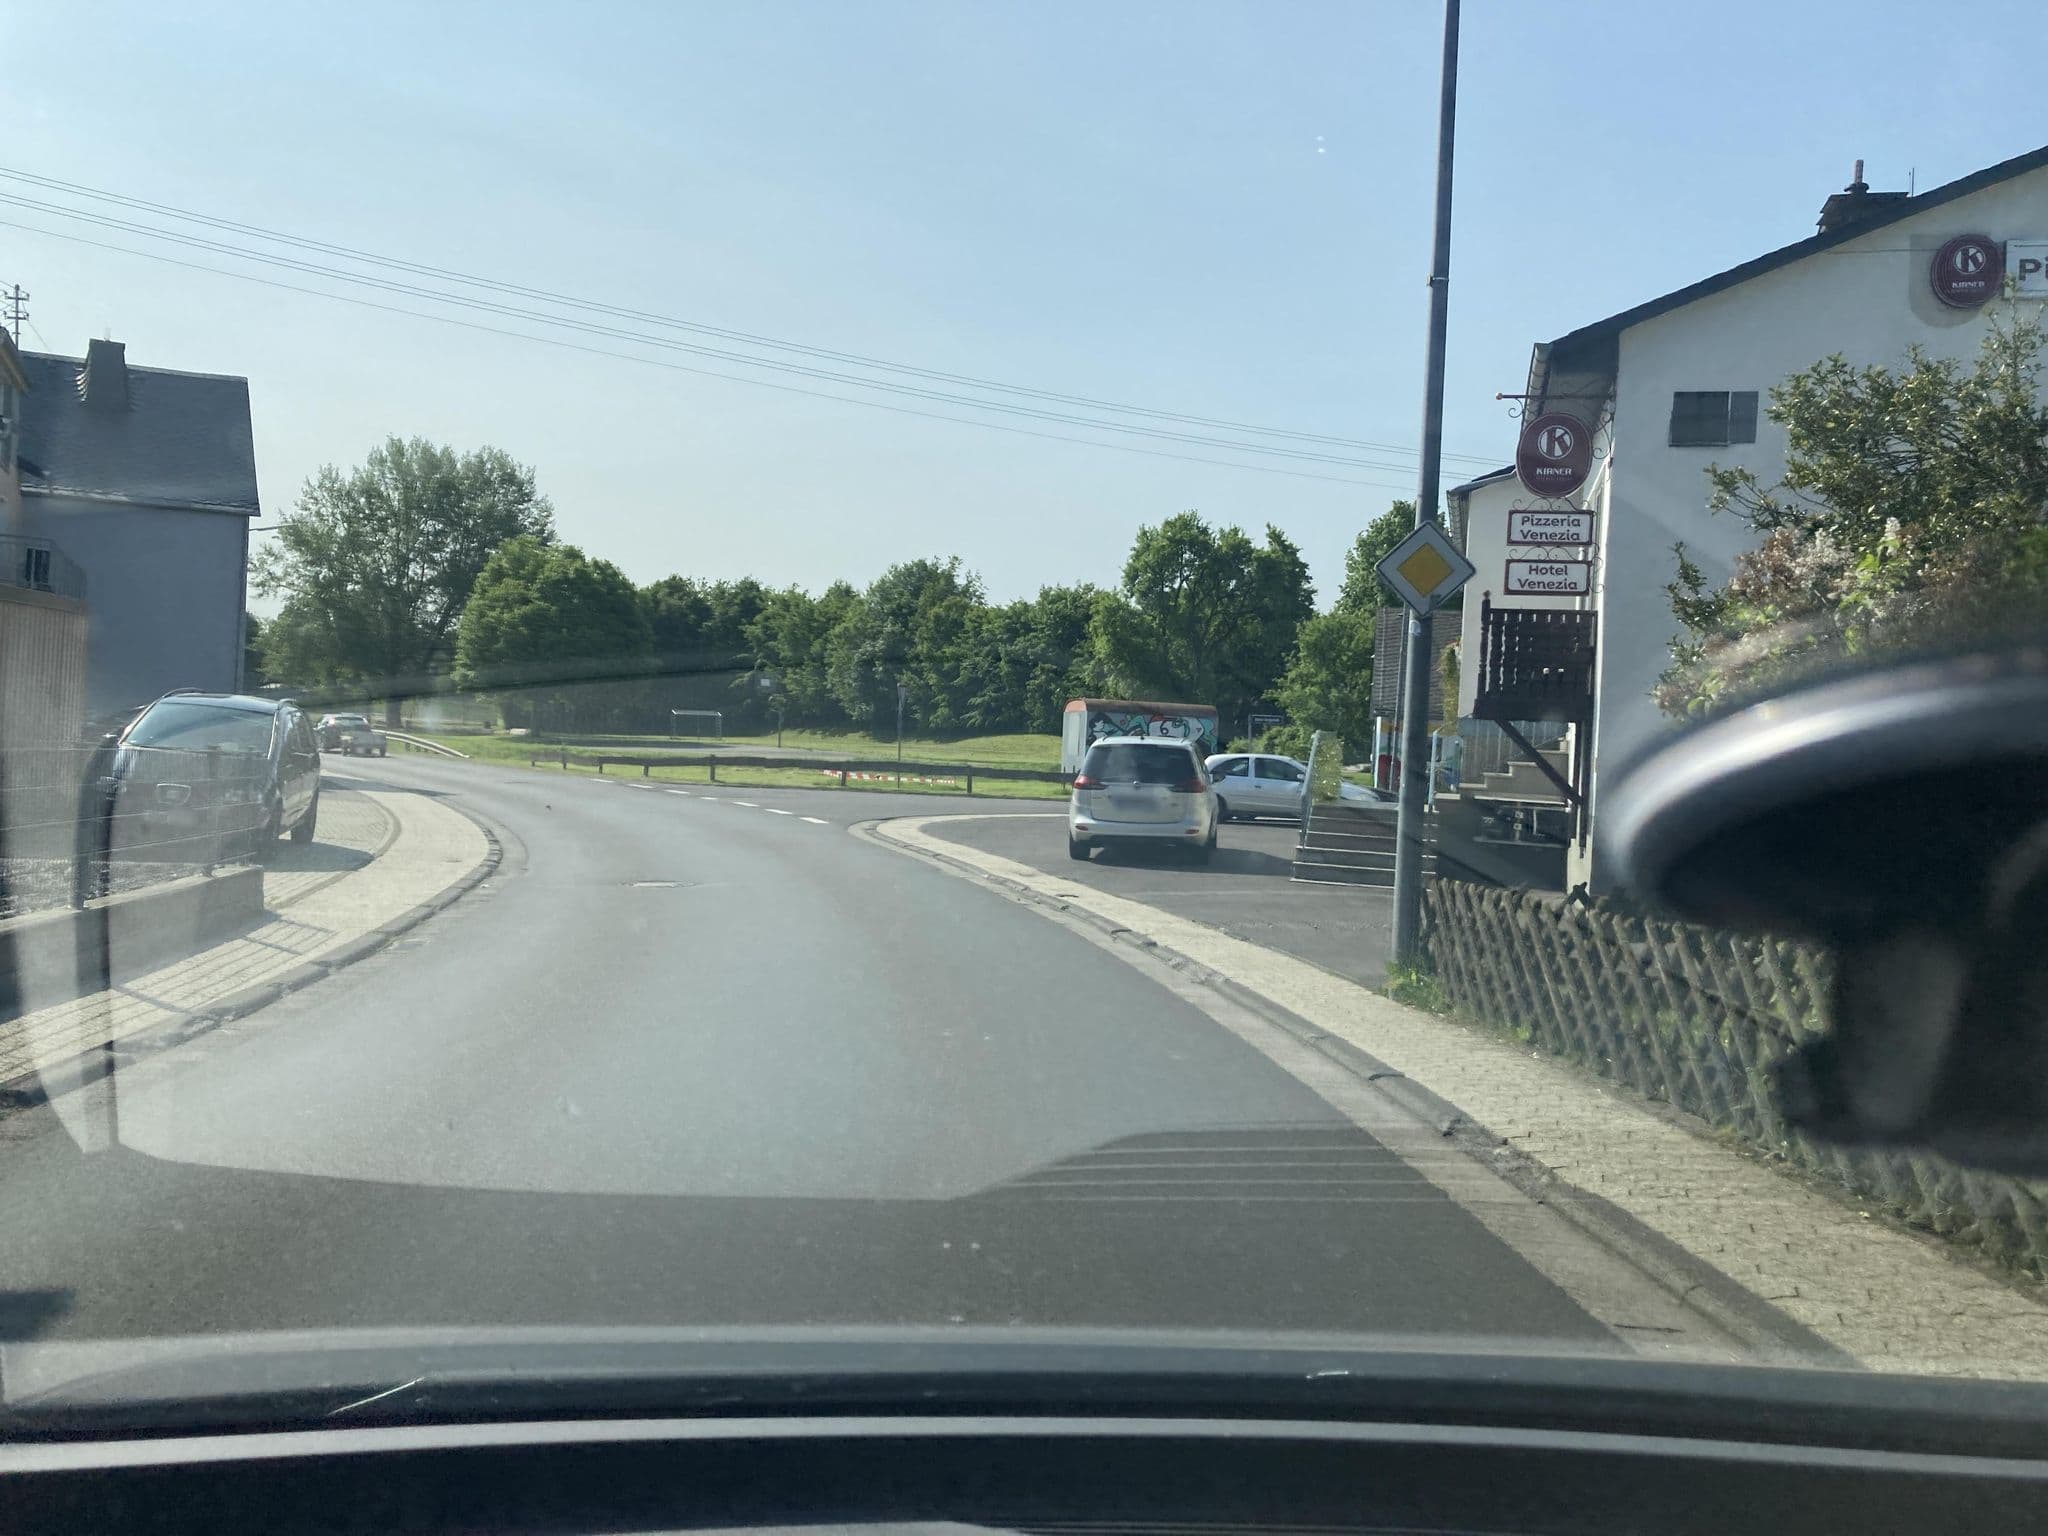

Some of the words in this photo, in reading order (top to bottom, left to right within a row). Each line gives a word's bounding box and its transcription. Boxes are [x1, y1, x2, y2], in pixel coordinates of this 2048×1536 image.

[1539, 426, 1573, 459] K
[1536, 467, 1572, 476] KIRNER
[1521, 515, 1581, 528] Pizzeria
[1520, 529, 1581, 541] Venezia
[1528, 564, 1568, 576] Hotel
[1517, 578, 1578, 590] Venezia
